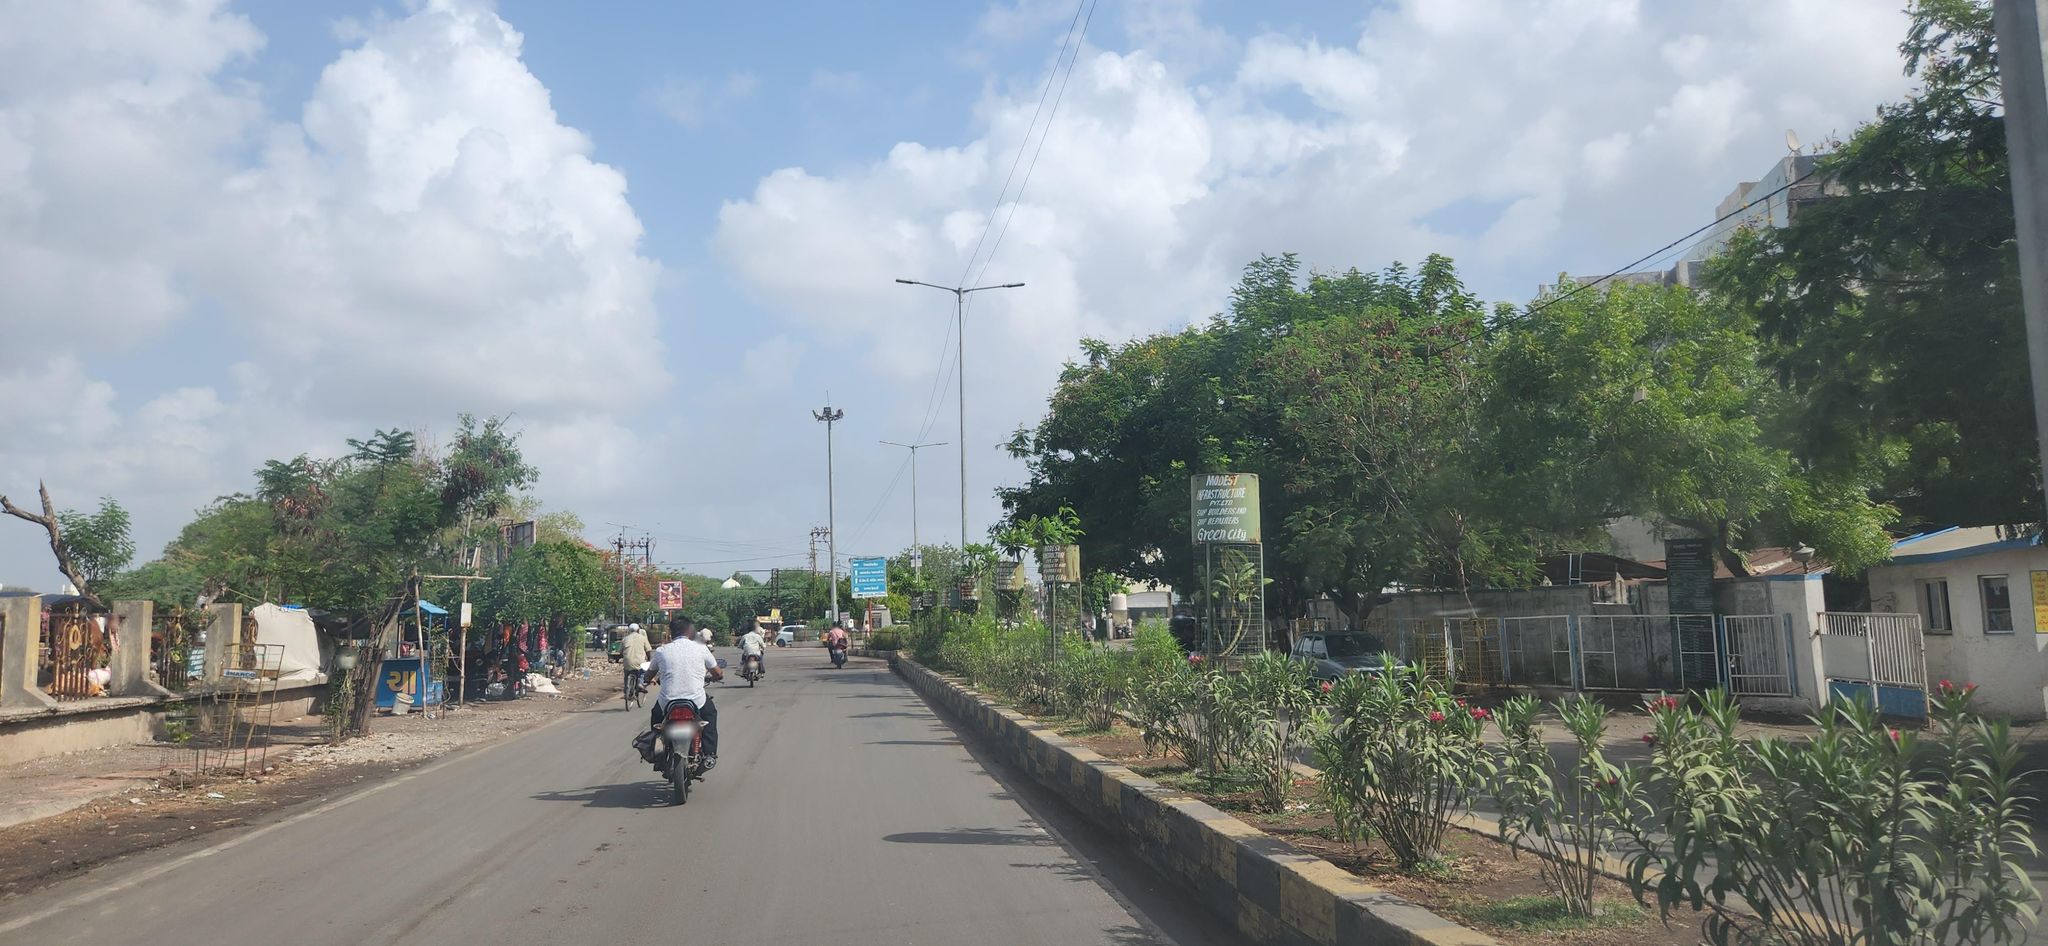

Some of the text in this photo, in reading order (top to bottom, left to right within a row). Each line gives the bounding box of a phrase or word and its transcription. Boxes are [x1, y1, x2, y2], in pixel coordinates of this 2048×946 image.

[1206, 474, 1239, 486] MODEST
[1197, 528, 1226, 541] Green
[386, 671, 416, 694] ચા
